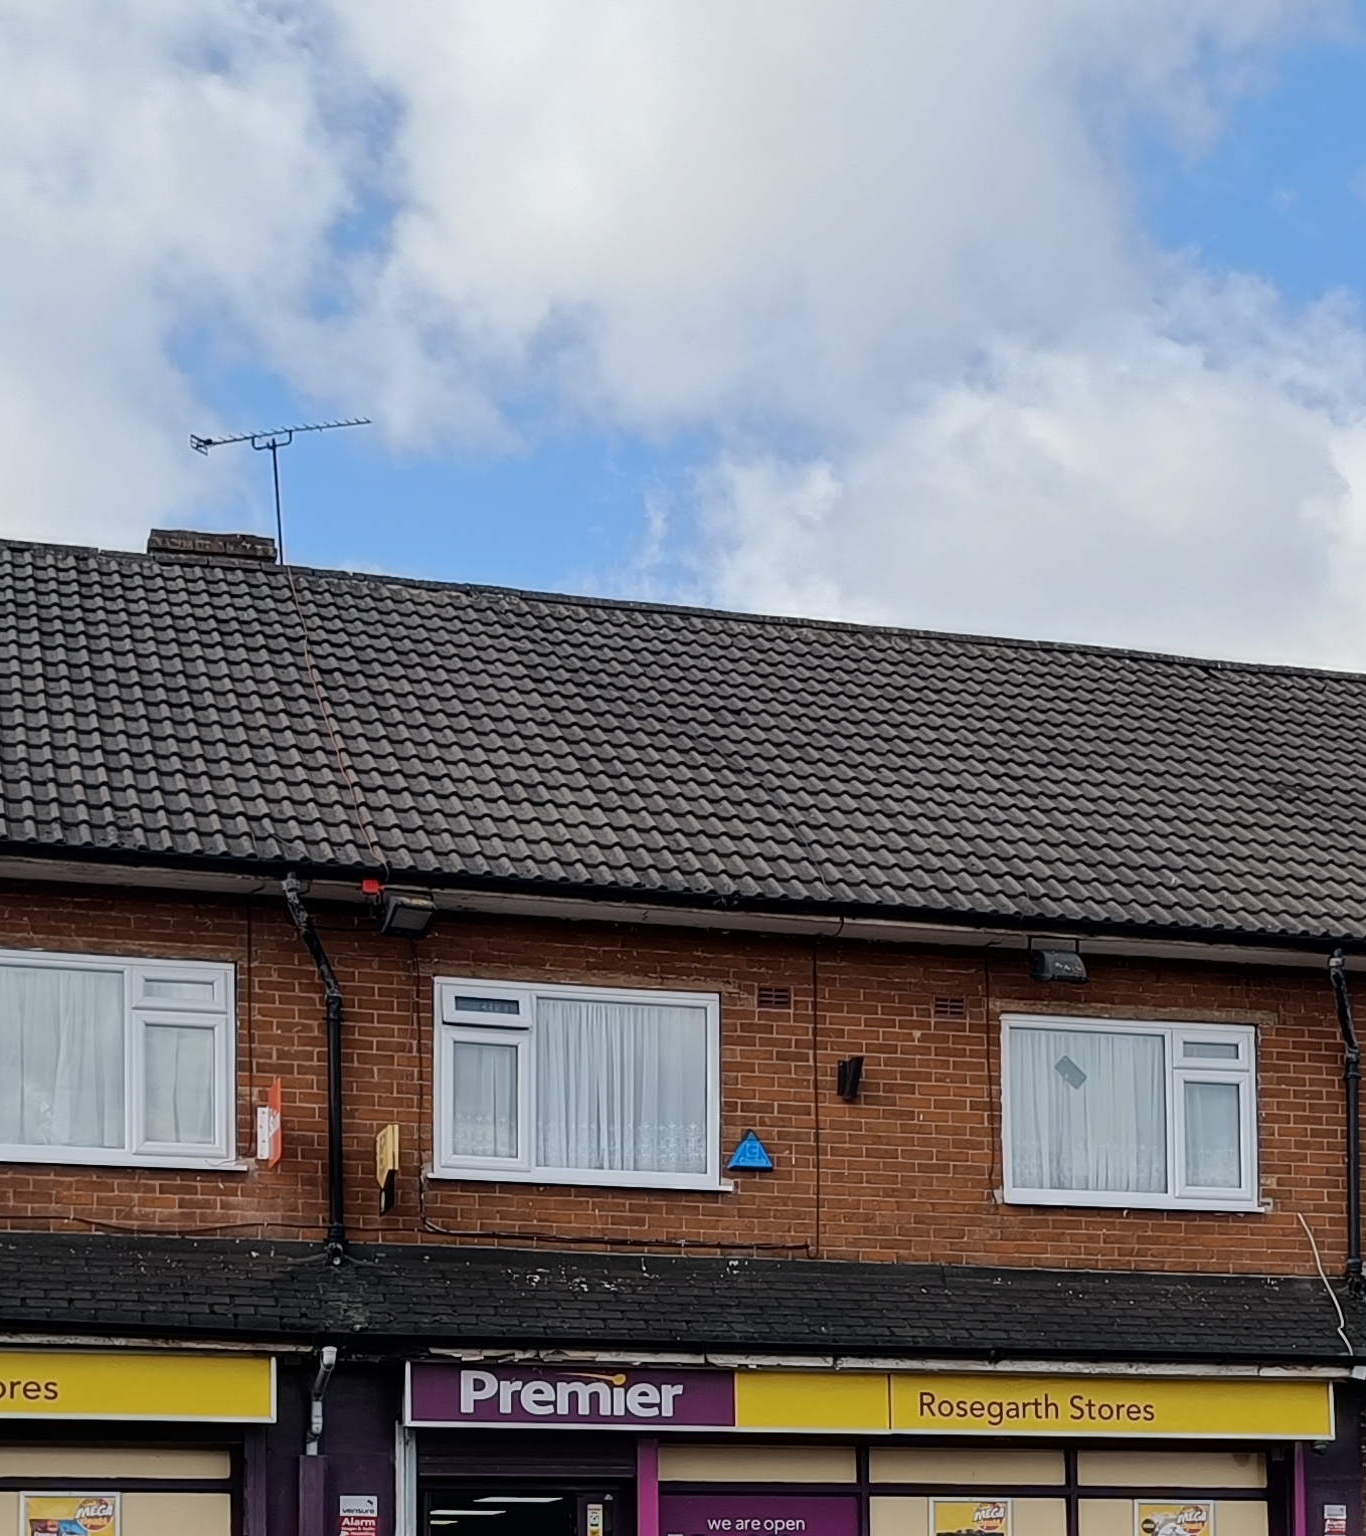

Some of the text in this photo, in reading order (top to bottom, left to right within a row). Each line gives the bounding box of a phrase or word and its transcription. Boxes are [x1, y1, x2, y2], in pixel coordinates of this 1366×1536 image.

[460, 1370, 683, 1417] Premier
[919, 1392, 1155, 1426] Rosegarth Stores
[75, 1504, 113, 1519] MEGA
[973, 1507, 1005, 1521] MEGA
[341, 1516, 376, 1527] Alarm
[707, 1518, 806, 1534] we are open
